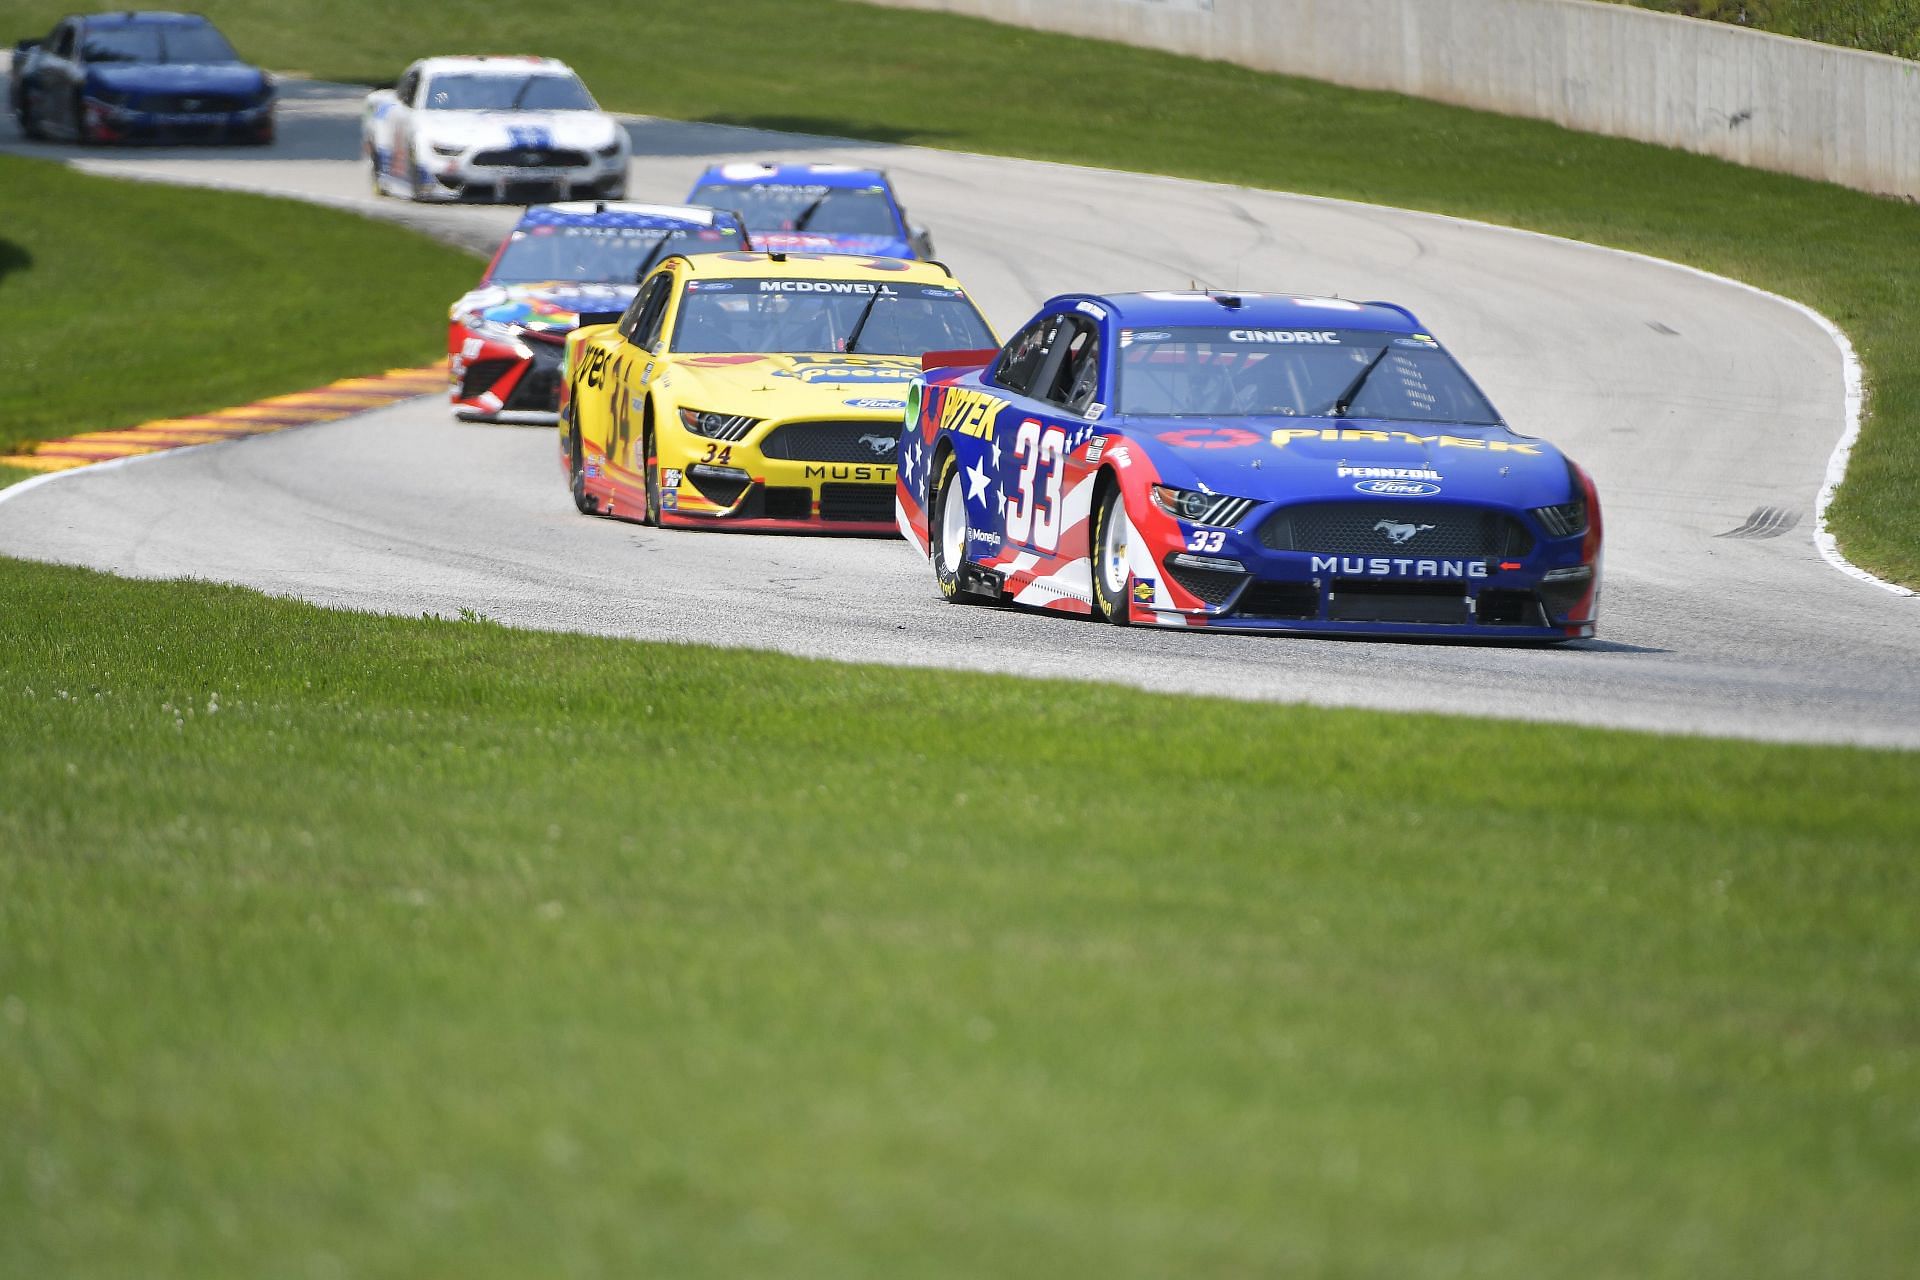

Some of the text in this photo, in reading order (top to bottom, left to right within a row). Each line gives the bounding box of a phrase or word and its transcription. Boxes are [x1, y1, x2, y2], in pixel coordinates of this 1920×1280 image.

[760, 281, 898, 295] MCDOWELL
[1228, 330, 1341, 345] CINDRIC
[700, 443, 732, 464] 34
[1336, 467, 1444, 481] PENNZOIL
[1004, 418, 1067, 556] 33
[1187, 530, 1227, 554] 33
[1310, 556, 1488, 578] MUSTANG
